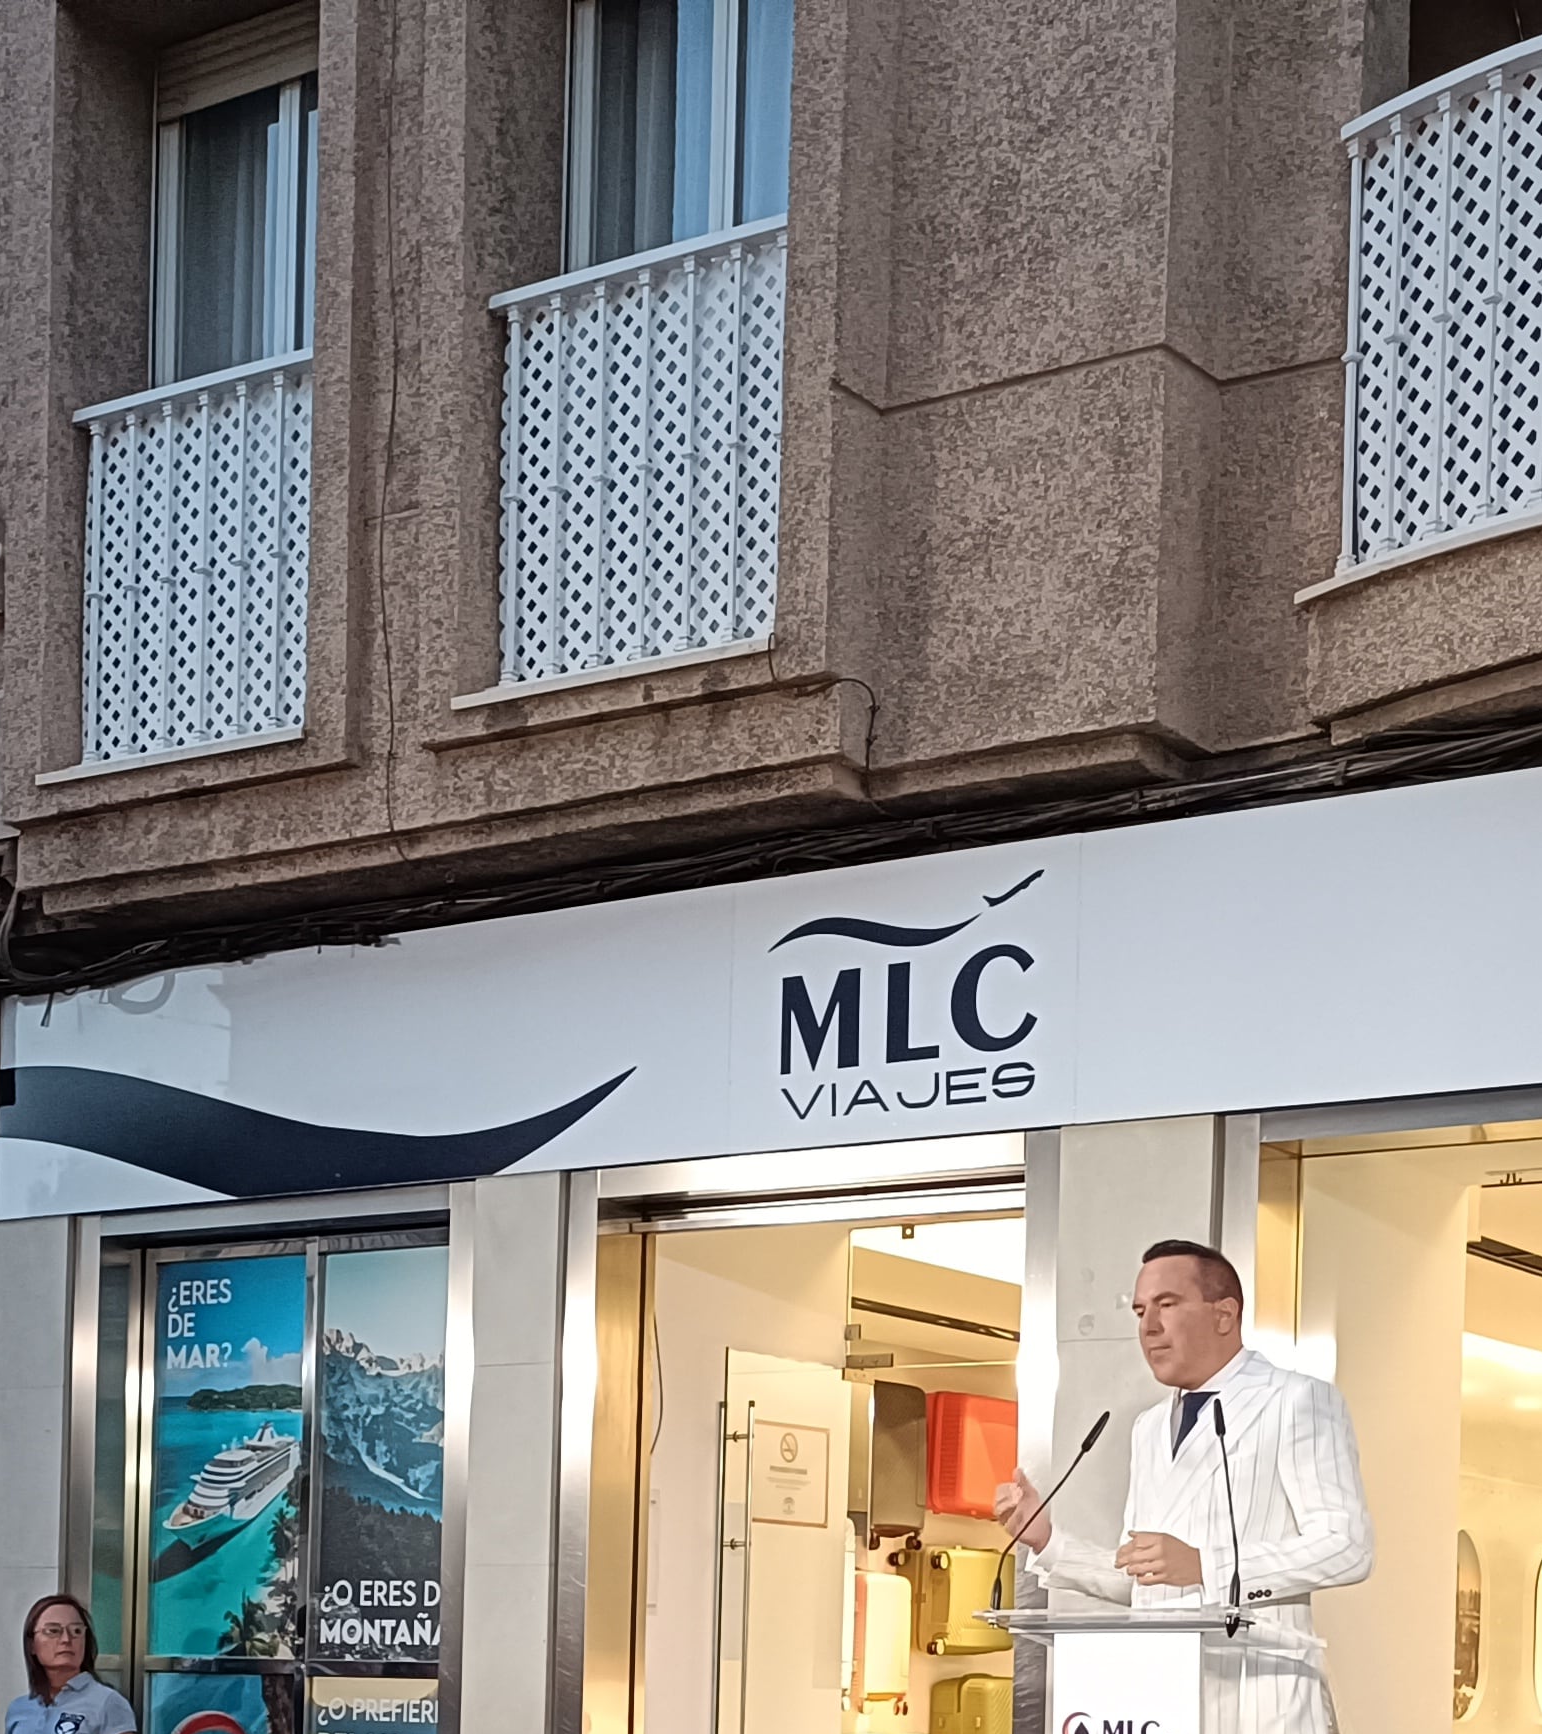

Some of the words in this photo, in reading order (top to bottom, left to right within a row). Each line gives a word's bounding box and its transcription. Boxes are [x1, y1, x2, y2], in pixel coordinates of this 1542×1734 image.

[780, 943, 1038, 1075] MLC
[780, 1061, 1036, 1120] VIAJES
[167, 1278, 233, 1313] ¿ERES
[167, 1312, 196, 1338] DE
[166, 1342, 233, 1370] MAR?
[320, 1579, 353, 1612] ¿O
[359, 1579, 417, 1608] ERES
[317, 1697, 347, 1726] ¿O
